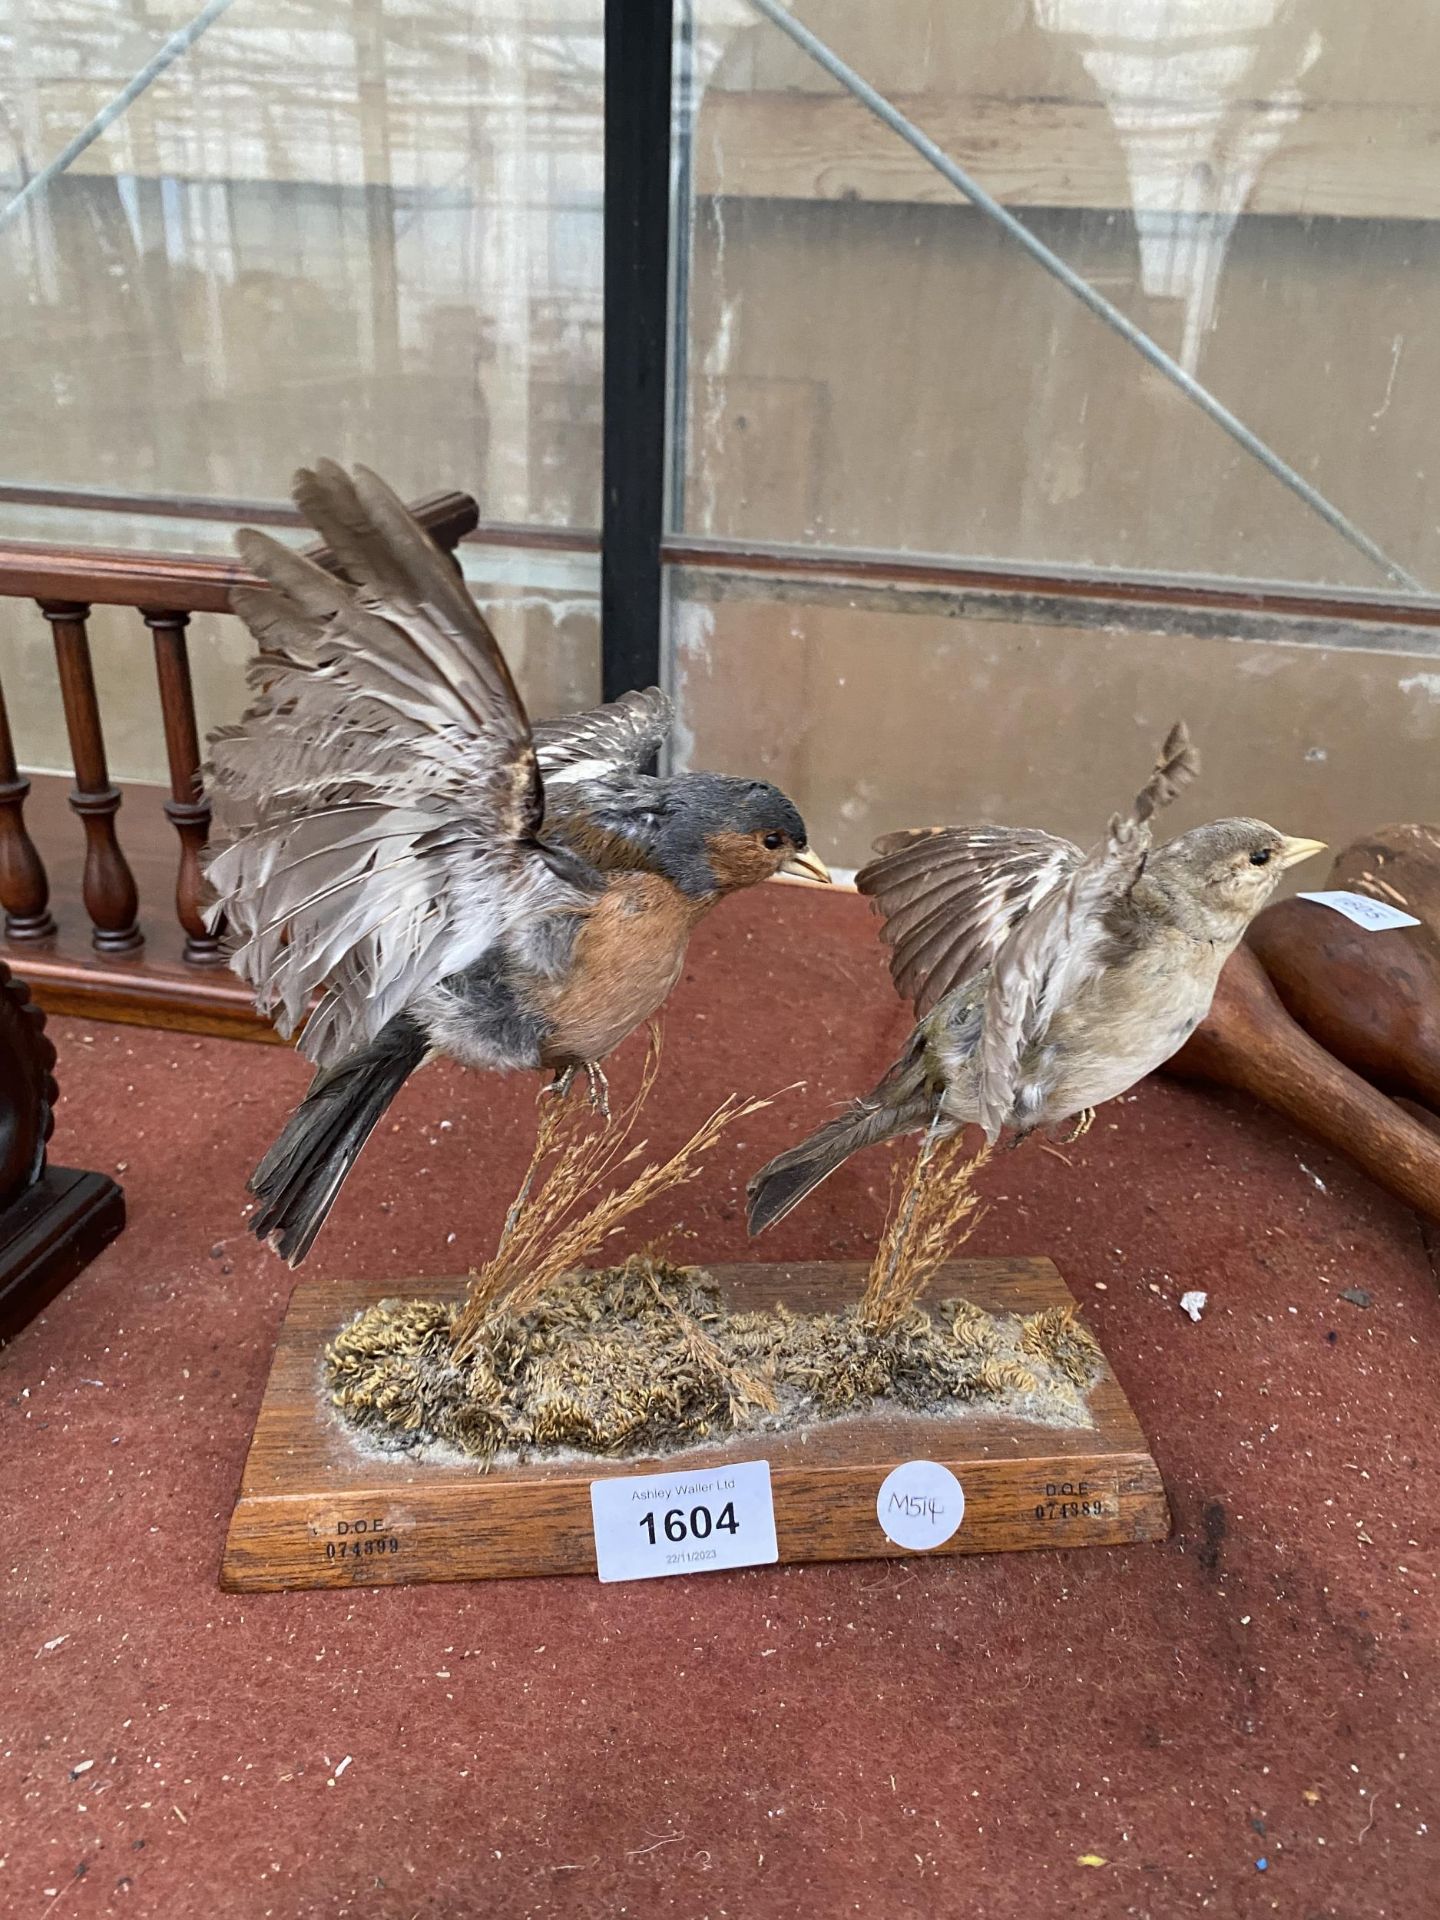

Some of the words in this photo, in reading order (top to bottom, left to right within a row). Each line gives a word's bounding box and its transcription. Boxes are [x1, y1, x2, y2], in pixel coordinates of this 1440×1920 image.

[632, 1488, 671, 1501] Ashley
[675, 1482, 713, 1496] Waller
[717, 1479, 735, 1491] Ltd
[639, 1501, 740, 1545] 1604
[666, 1550, 717, 1564] 22/11/2023
